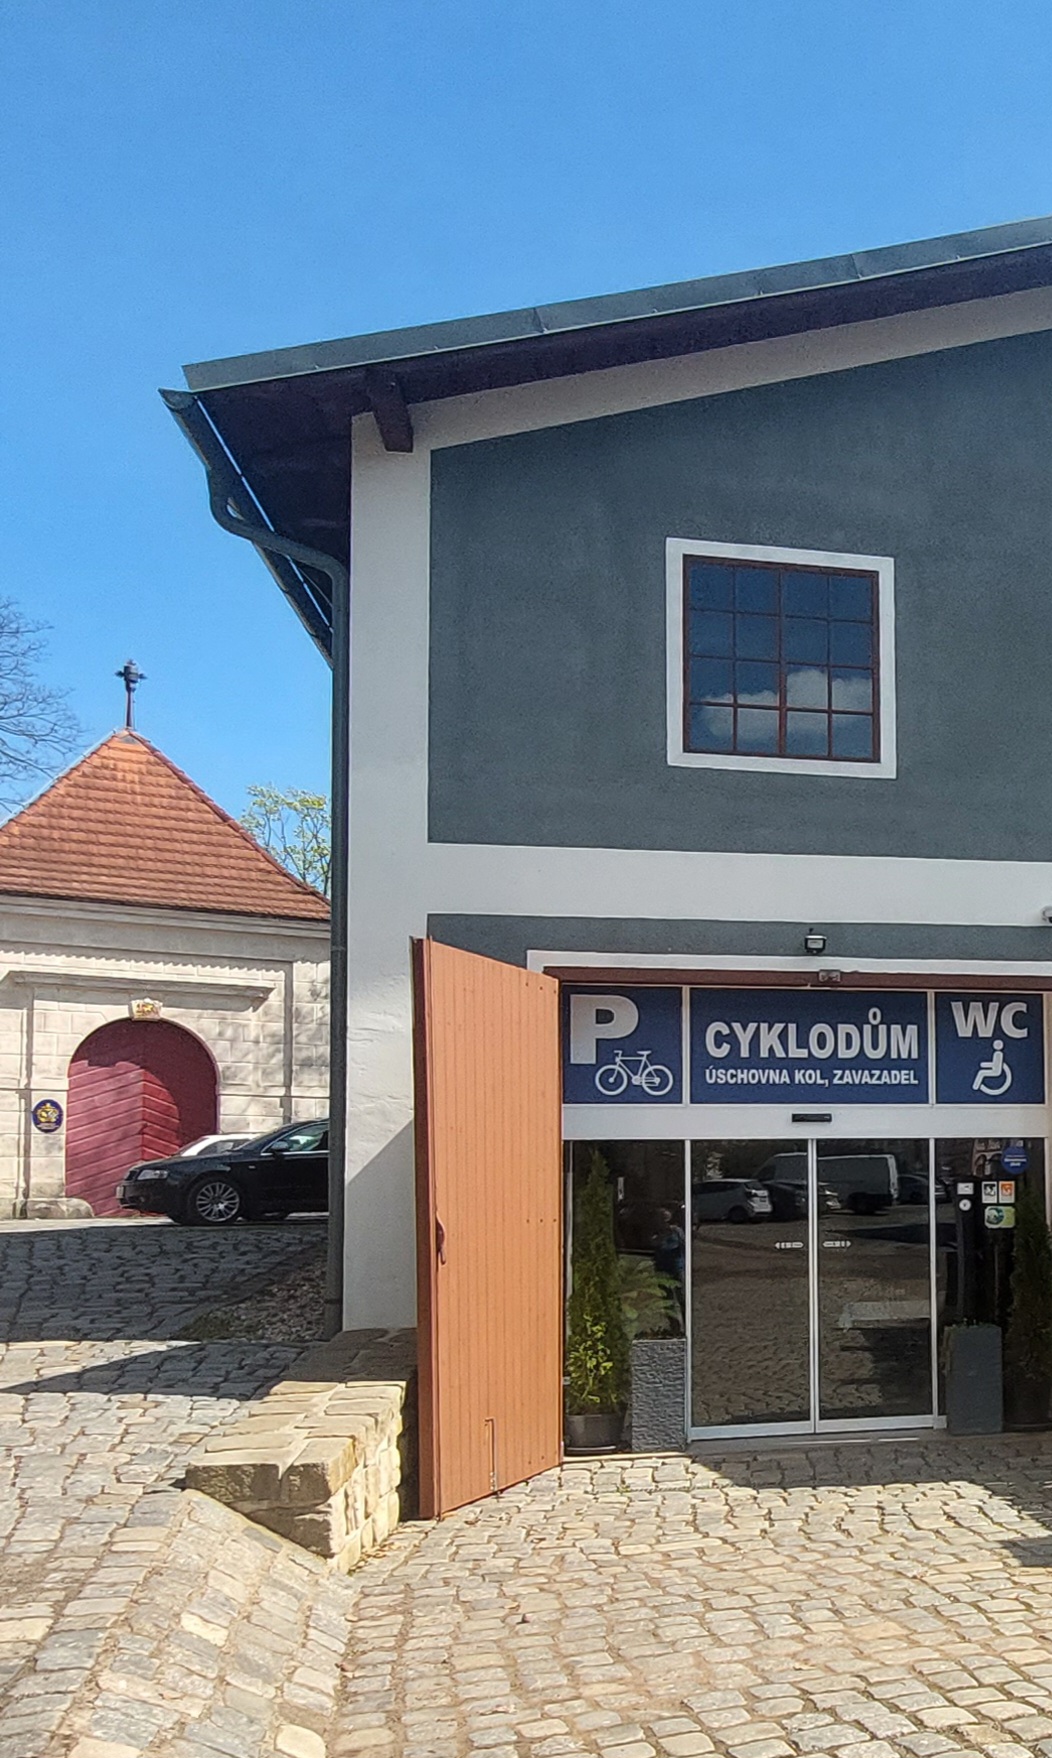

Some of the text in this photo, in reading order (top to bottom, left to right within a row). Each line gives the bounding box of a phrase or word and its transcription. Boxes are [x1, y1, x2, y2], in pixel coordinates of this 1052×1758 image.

[570, 994, 639, 1065] P
[705, 1007, 919, 1060] CYKLODŮM
[951, 1001, 1029, 1039] WC
[705, 1065, 919, 1088] ÚSCHOVNA KOL, ZAVAZADEL
